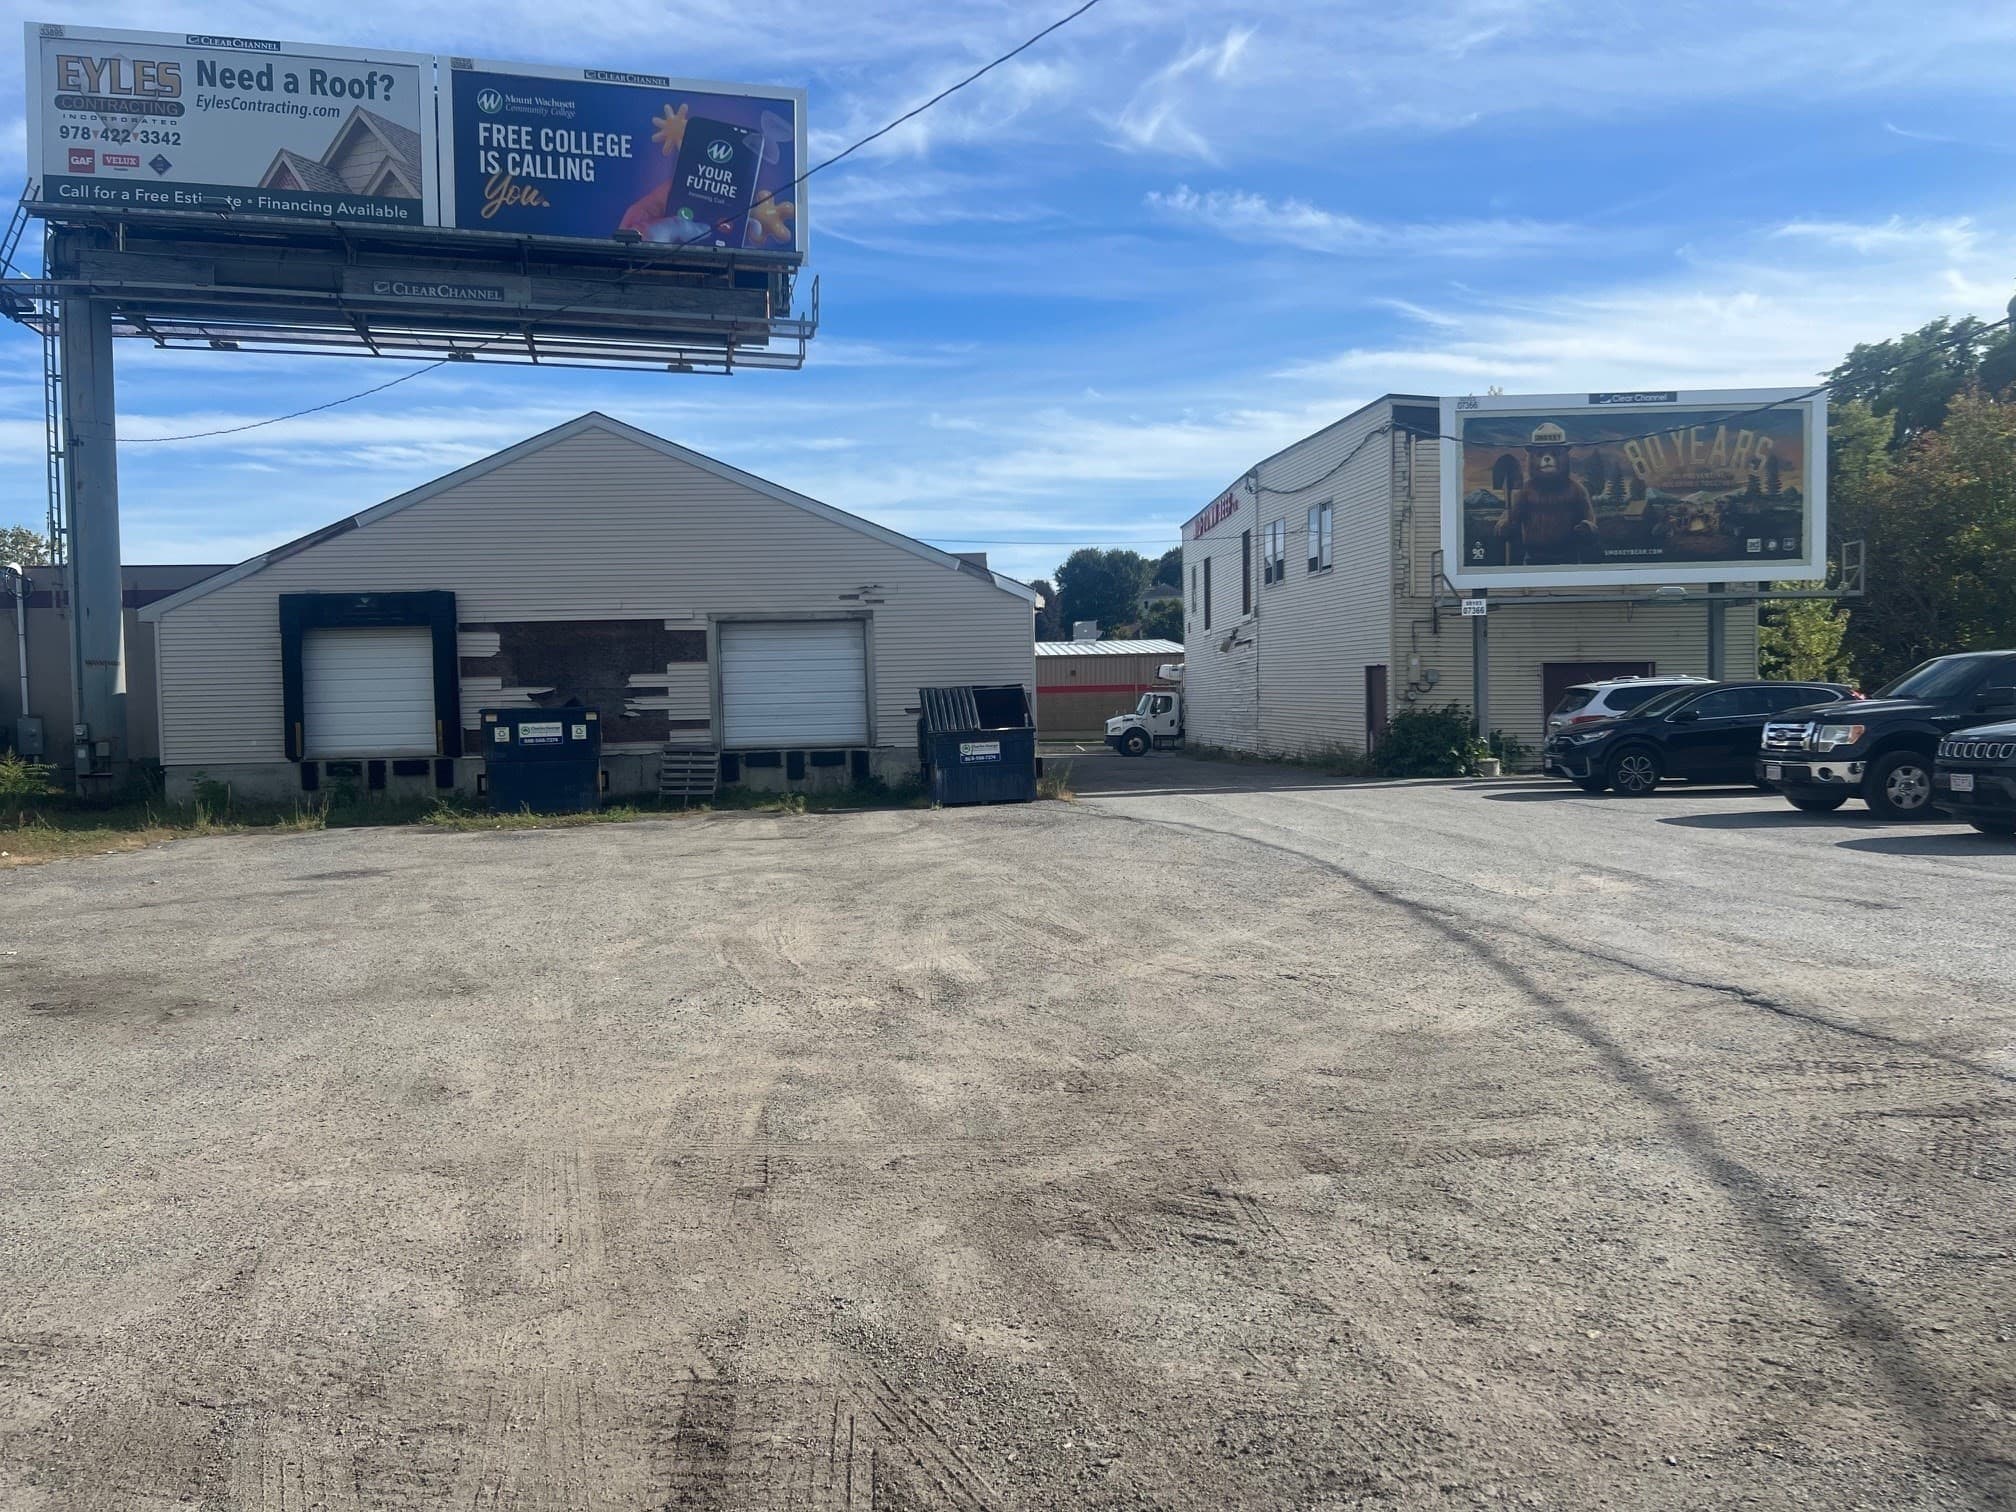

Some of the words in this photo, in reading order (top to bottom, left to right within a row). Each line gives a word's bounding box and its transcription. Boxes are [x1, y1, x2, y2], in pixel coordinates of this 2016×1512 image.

[55, 54, 182, 99] EYLES
[196, 60, 274, 92] Need
[283, 73, 300, 94] a
[310, 68, 395, 102] Roof?
[61, 96, 179, 115] CONTRACTING
[196, 94, 341, 119] EylesContracting.com
[505, 93, 533, 105] Mount
[534, 96, 576, 111] Wachusett
[505, 104, 549, 117] Community
[550, 107, 576, 120] College
[62, 113, 178, 126] INCORPORATED
[59, 125, 91, 140] 978
[100, 128, 131, 143] 422
[140, 130, 181, 146] 3342
[478, 122, 534, 150] FREE
[540, 128, 633, 158] COLLEGE
[70, 156, 93, 165] GAF
[105, 156, 137, 166] VELUX
[480, 150, 500, 175] IS
[507, 152, 595, 182] CALLING
[697, 163, 733, 184] YOUR
[480, 169, 551, 219] You.
[686, 175, 738, 199] FUTURE
[58, 184, 89, 199] Call
[94, 185, 118, 200] for
[121, 190, 131, 200] a
[135, 187, 169, 203] Free
[174, 190, 243, 208] Estite
[257, 195, 333, 217] Financing
[337, 201, 409, 220] Available
[392, 281, 502, 301] CLEARCHANNEL
[1612, 394, 1634, 403] Clear
[1635, 392, 1668, 402] Channel
[1624, 432, 1667, 481] 80
[1666, 424, 1774, 473] YEARS
